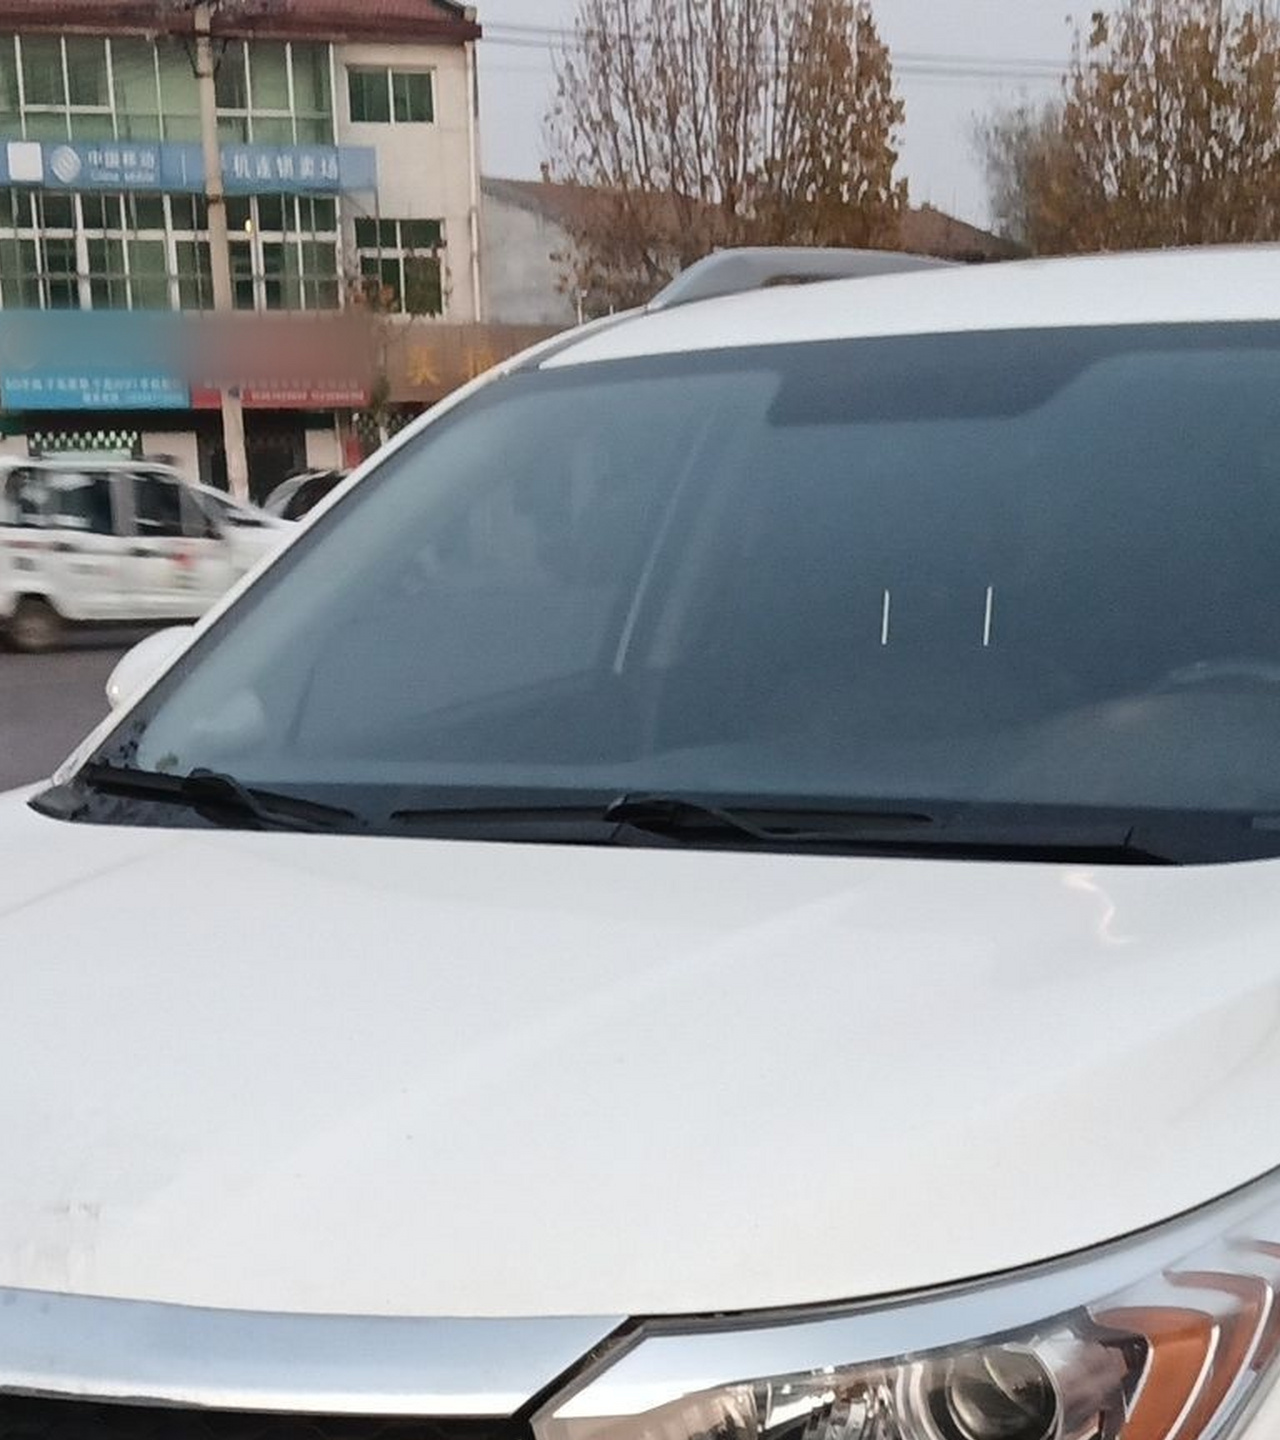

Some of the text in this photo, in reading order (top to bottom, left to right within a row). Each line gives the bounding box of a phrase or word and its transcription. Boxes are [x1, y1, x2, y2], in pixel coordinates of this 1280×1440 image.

[221, 152, 338, 180] 机连锁卖场
